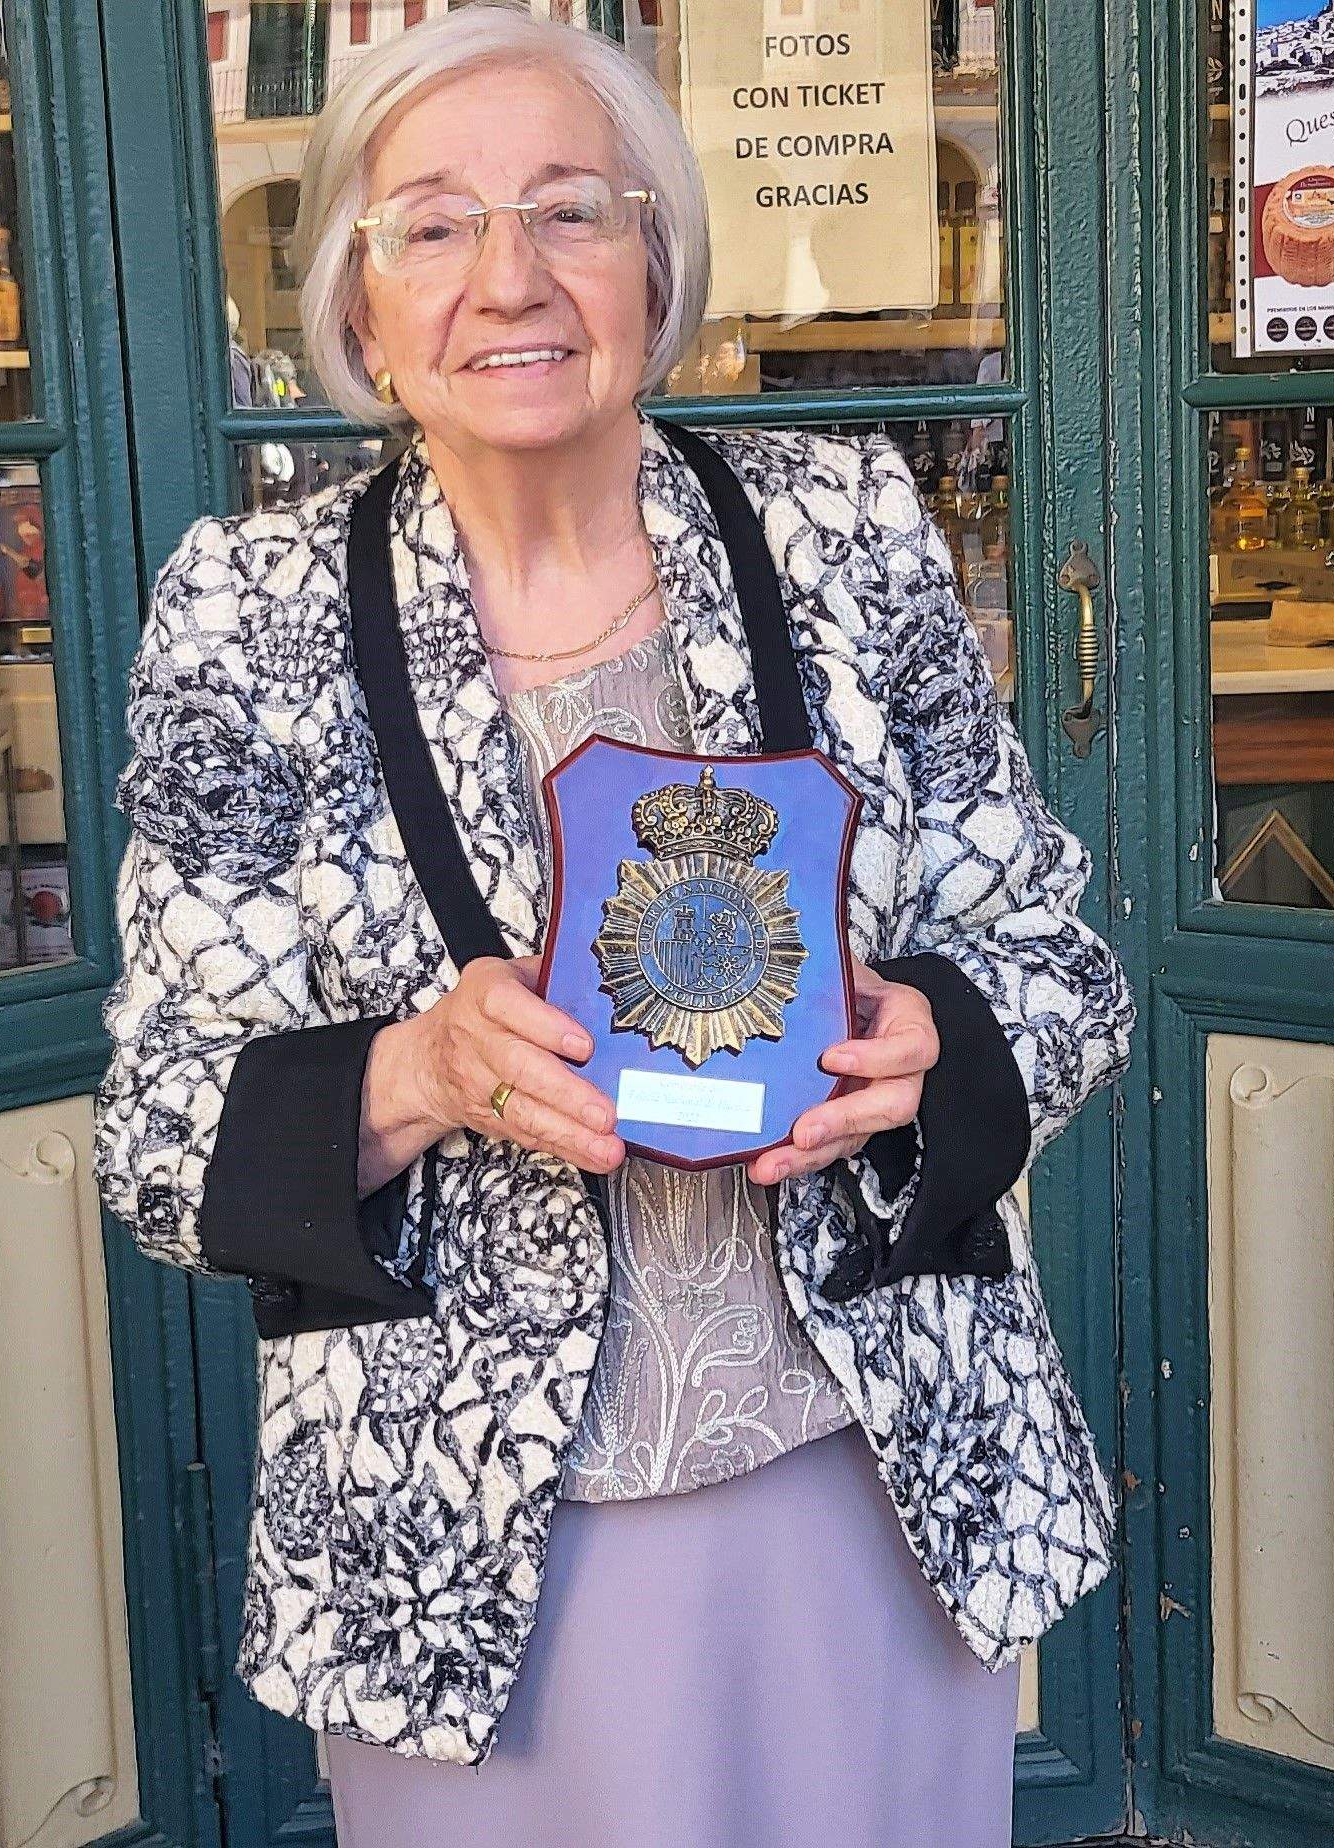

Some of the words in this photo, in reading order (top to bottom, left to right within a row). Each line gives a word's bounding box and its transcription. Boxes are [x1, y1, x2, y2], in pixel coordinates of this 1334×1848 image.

[765, 34, 850, 57] FOTOS
[733, 87, 789, 109] CON
[797, 83, 885, 107] TICKET
[735, 137, 768, 159] DE
[777, 133, 894, 157] COMPRA
[756, 183, 869, 208] GRACIAS
[662, 982, 742, 1008] POLICIA
